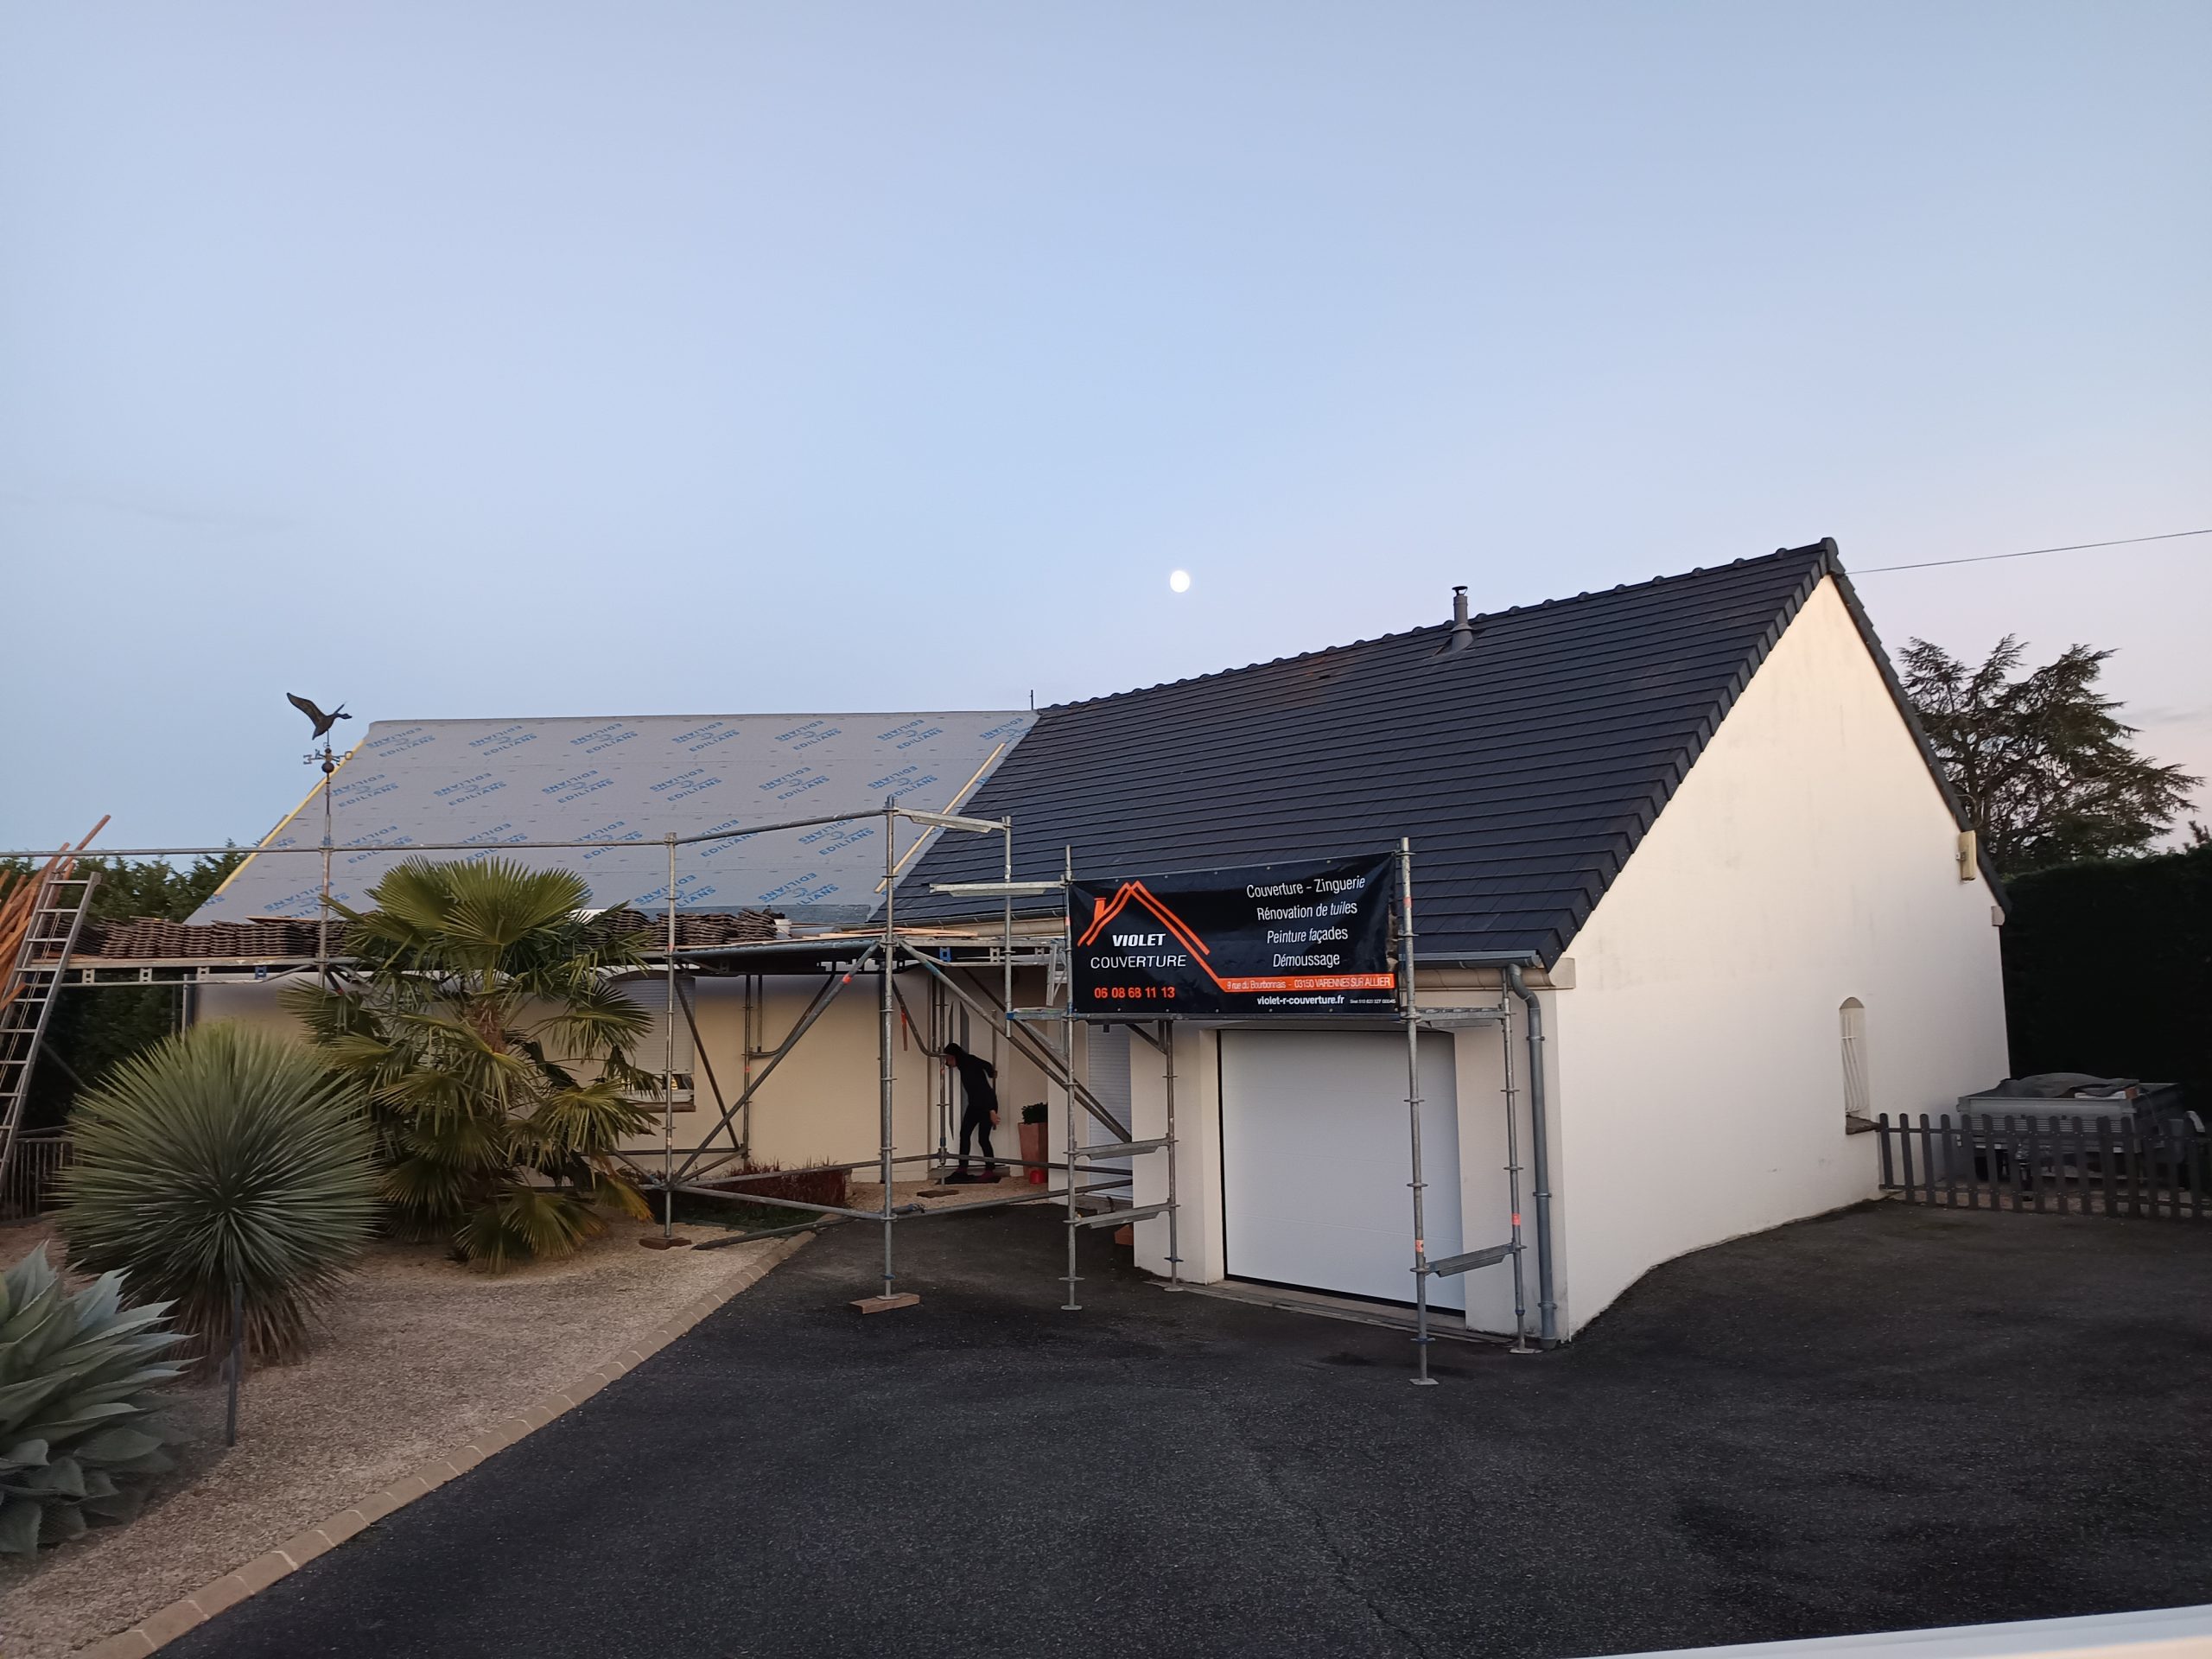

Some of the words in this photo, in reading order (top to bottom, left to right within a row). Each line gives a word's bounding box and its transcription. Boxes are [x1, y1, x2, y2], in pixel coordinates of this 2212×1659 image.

[774, 721, 823, 741] EDILIANS
[792, 730, 842, 750] EDILIANS
[877, 719, 925, 740] EDILIANS
[896, 729, 944, 749] EDILIANS
[378, 736, 435, 757] EDILIANS
[484, 734, 537, 756] EDILIANS
[586, 733, 639, 753] EDILIANS
[689, 732, 740, 752] EDILIANS
[331, 774, 385, 795] EDILIAN
[542, 770, 598, 792] EDILIANS
[650, 768, 705, 791] EDILIANS
[759, 766, 811, 790] EDILIANS
[868, 766, 918, 788] EDILIANS
[338, 784, 399, 807] EDILIANS
[448, 782, 507, 806] EDILIANS
[557, 780, 613, 804] EDILIANS
[666, 779, 721, 802] EDILIANS
[778, 778, 830, 800] EDILIANS
[818, 830, 874, 855] EDILIANS
[759, 873, 817, 900] EDILIANS
[797, 887, 839, 906] ILIANS
[1246, 881, 1304, 899] Couverture
[1313, 874, 1366, 894] Zinguerie
[1256, 904, 1313, 921] Rénovation
[1315, 904, 1328, 917] de
[1331, 901, 1357, 915] tuiles
[1112, 933, 1166, 947] VIOLET
[1267, 930, 1306, 944] Peinture
[1308, 926, 1349, 944] façades
[1090, 955, 1187, 969] COUVERTURE
[1273, 953, 1340, 968] Démoussage
[1094, 987, 1109, 999] 06
[1111, 987, 1126, 999] 08
[1128, 987, 1141, 998] 68
[1145, 987, 1156, 998] 11
[1161, 986, 1175, 998] 13
[1242, 981, 1249, 989] du
[1250, 980, 1287, 989] Bourbonnais
[1294, 979, 1314, 988] 03150
[1314, 977, 1349, 988] VARENNES
[1351, 977, 1364, 987] SUR
[1365, 976, 1391, 987] ALLIER
[1256, 995, 1344, 1005] violet-r-couverture.fr
